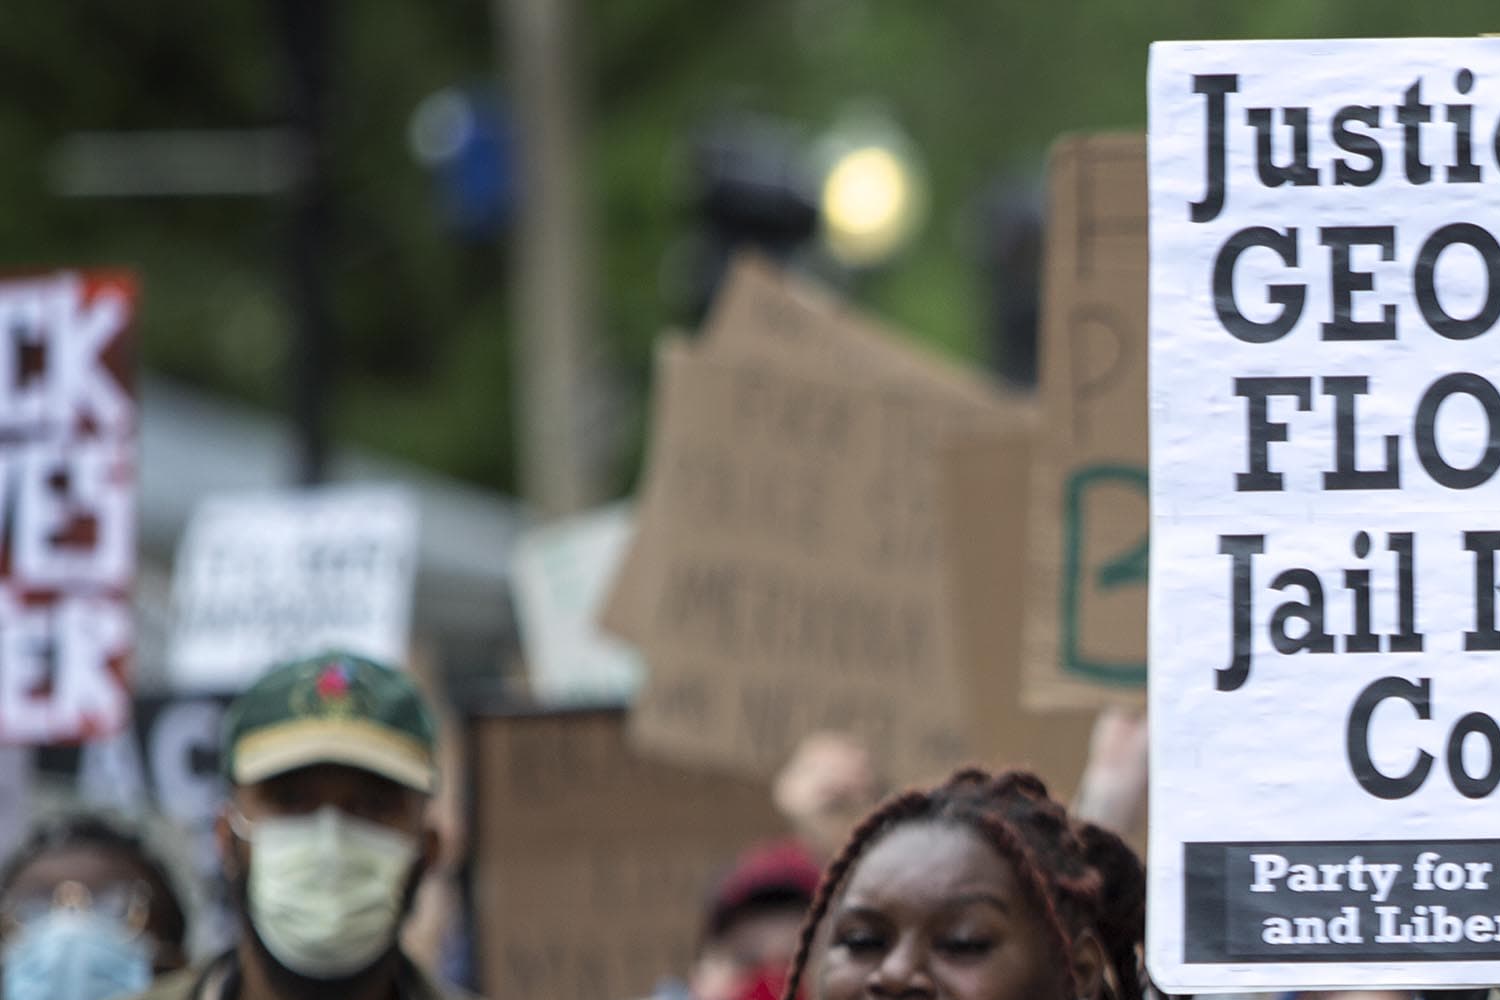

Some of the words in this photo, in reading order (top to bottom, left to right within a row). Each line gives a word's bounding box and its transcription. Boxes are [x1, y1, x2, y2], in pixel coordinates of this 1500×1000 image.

[1215, 531, 1424, 693] Jail
[1250, 853, 1402, 902] Party
[1413, 852, 1493, 891] for
[1262, 907, 1364, 944] and
